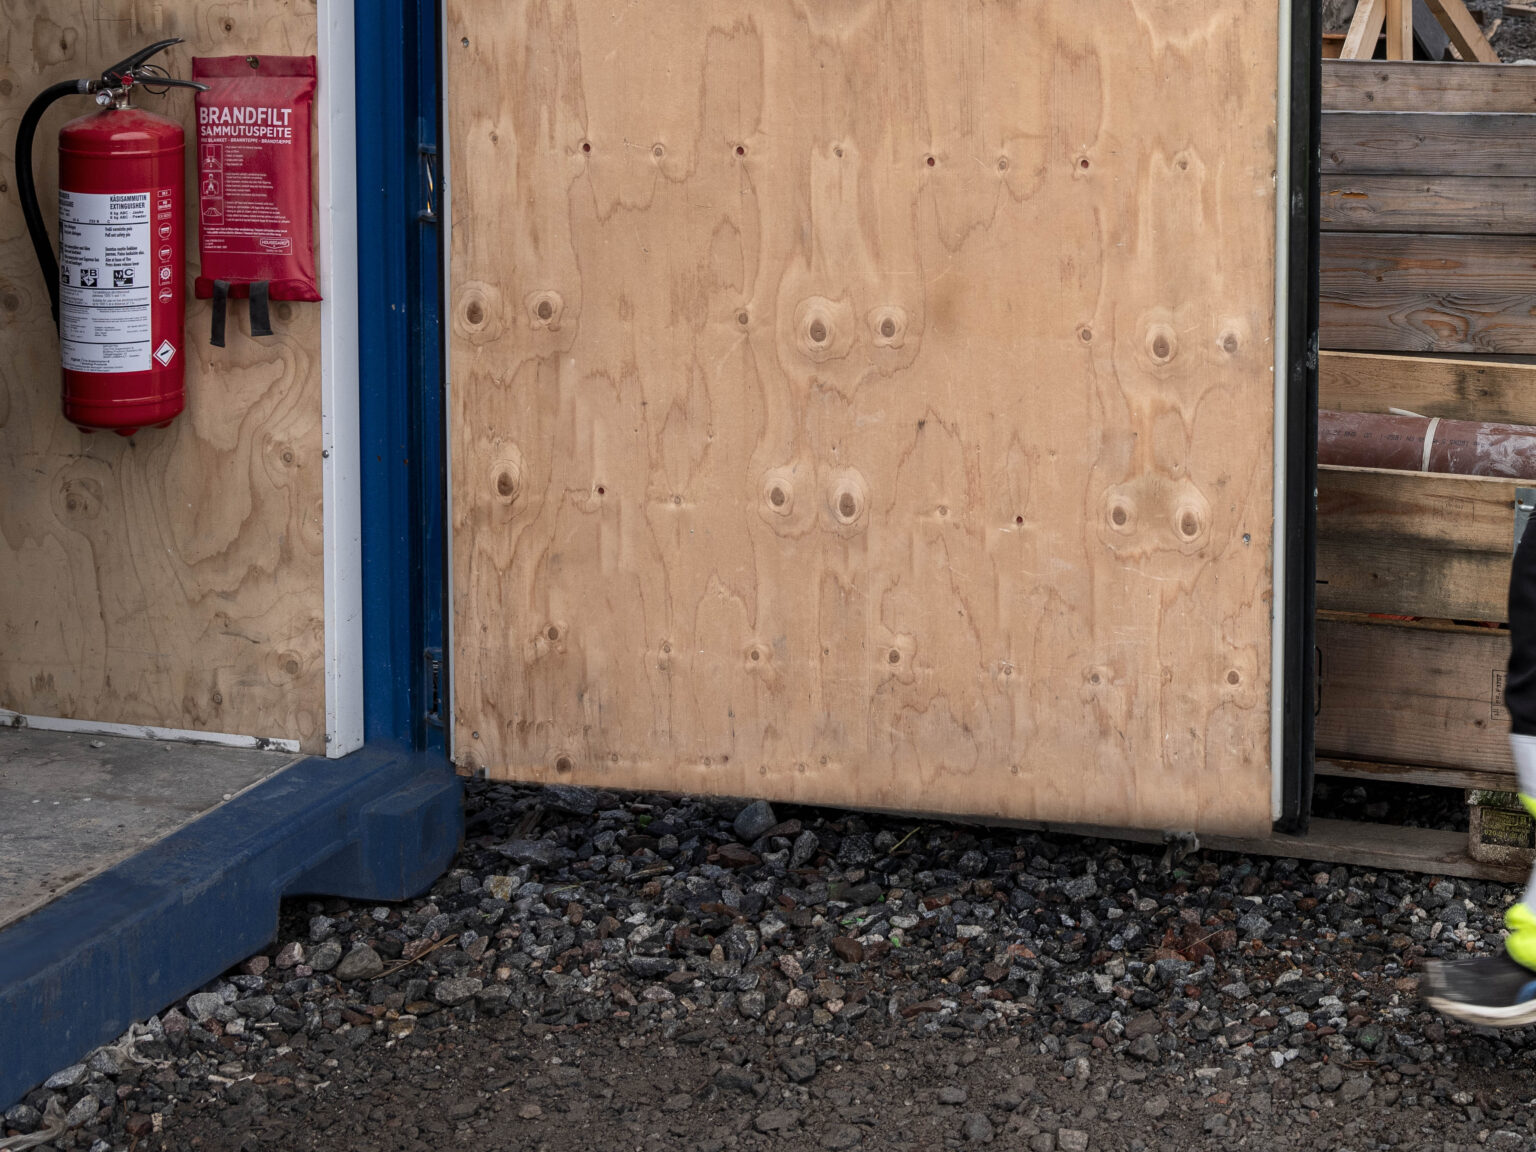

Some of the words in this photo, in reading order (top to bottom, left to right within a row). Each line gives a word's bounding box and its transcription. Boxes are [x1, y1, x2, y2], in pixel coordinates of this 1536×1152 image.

[199, 106, 292, 125] BRANDFILT
[201, 126, 292, 138] SAMMUTUSPEITE
[110, 202, 145, 210] EXTINGUISHER
[90, 269, 98, 277] B
[124, 268, 134, 276] C
